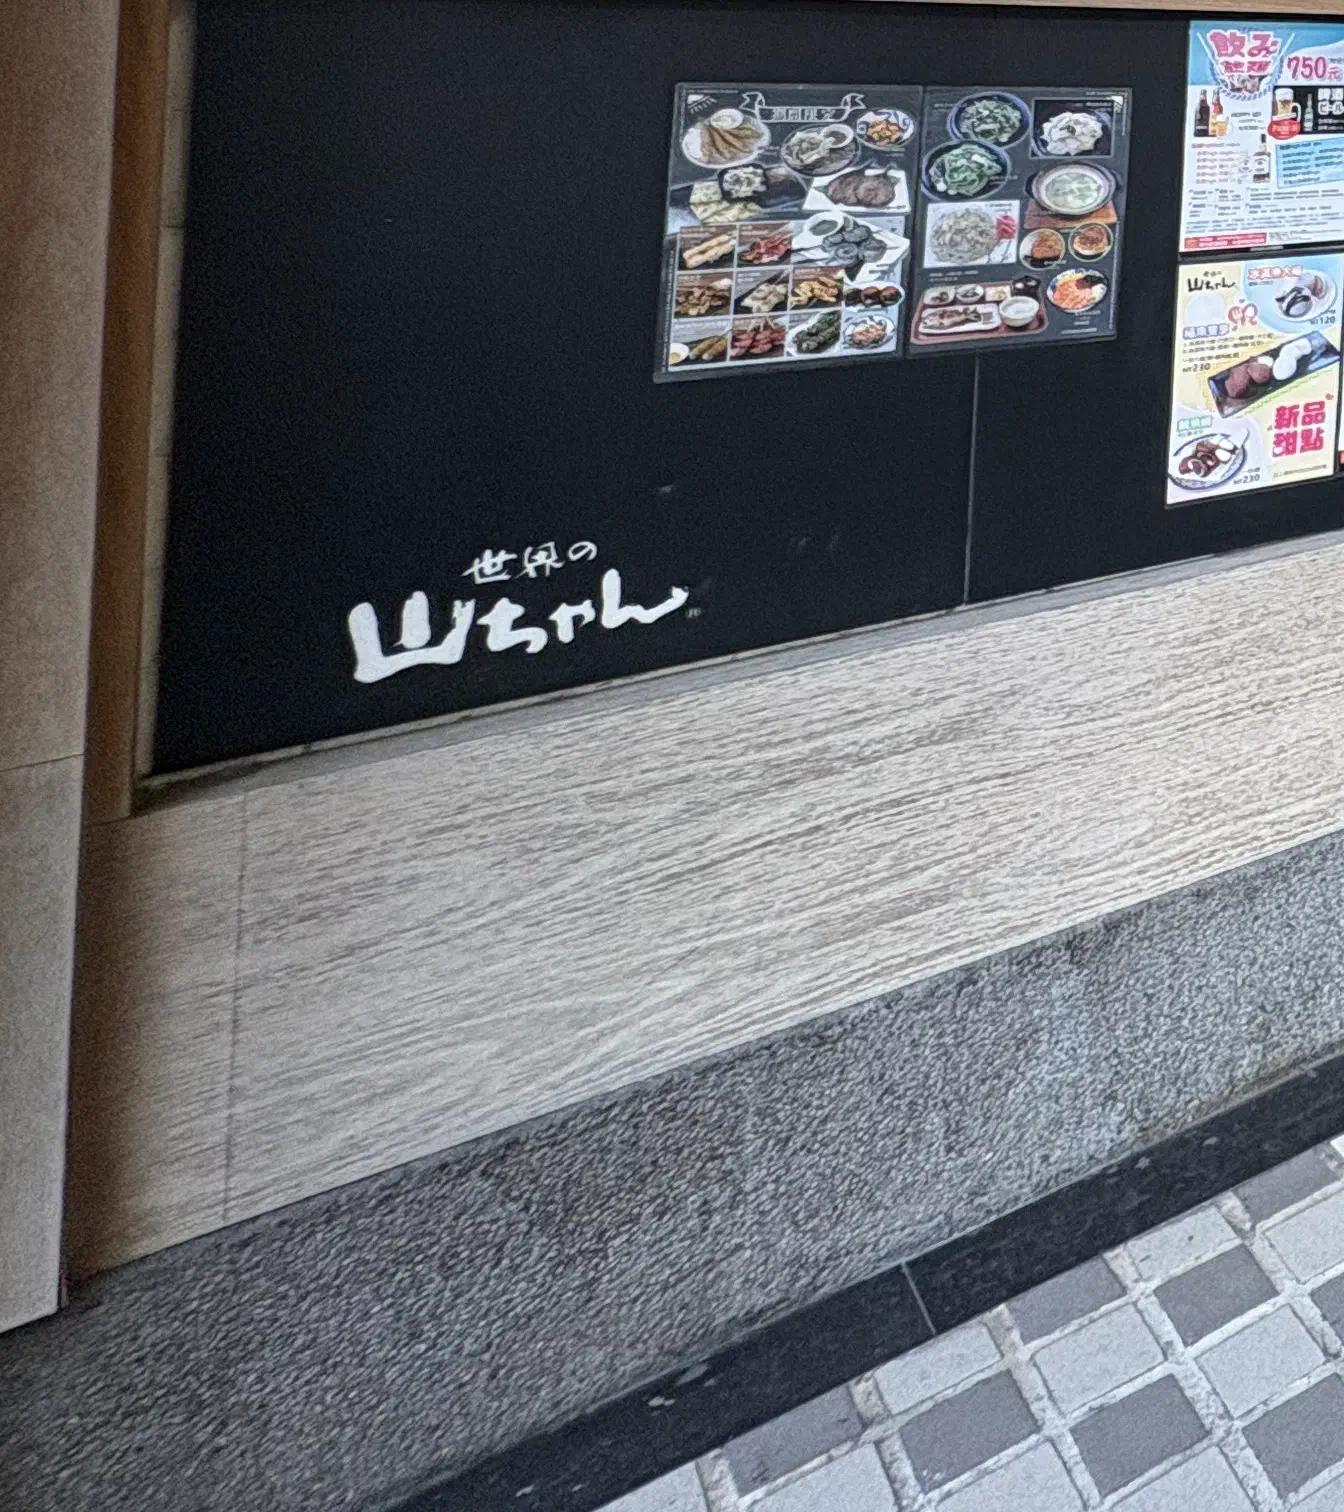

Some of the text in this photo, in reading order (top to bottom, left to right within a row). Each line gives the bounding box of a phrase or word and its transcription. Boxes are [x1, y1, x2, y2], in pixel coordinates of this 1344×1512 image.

[1274, 401, 1326, 429] 新品
[461, 541, 598, 584] 世界の
[347, 569, 689, 683] 山ちゃん
